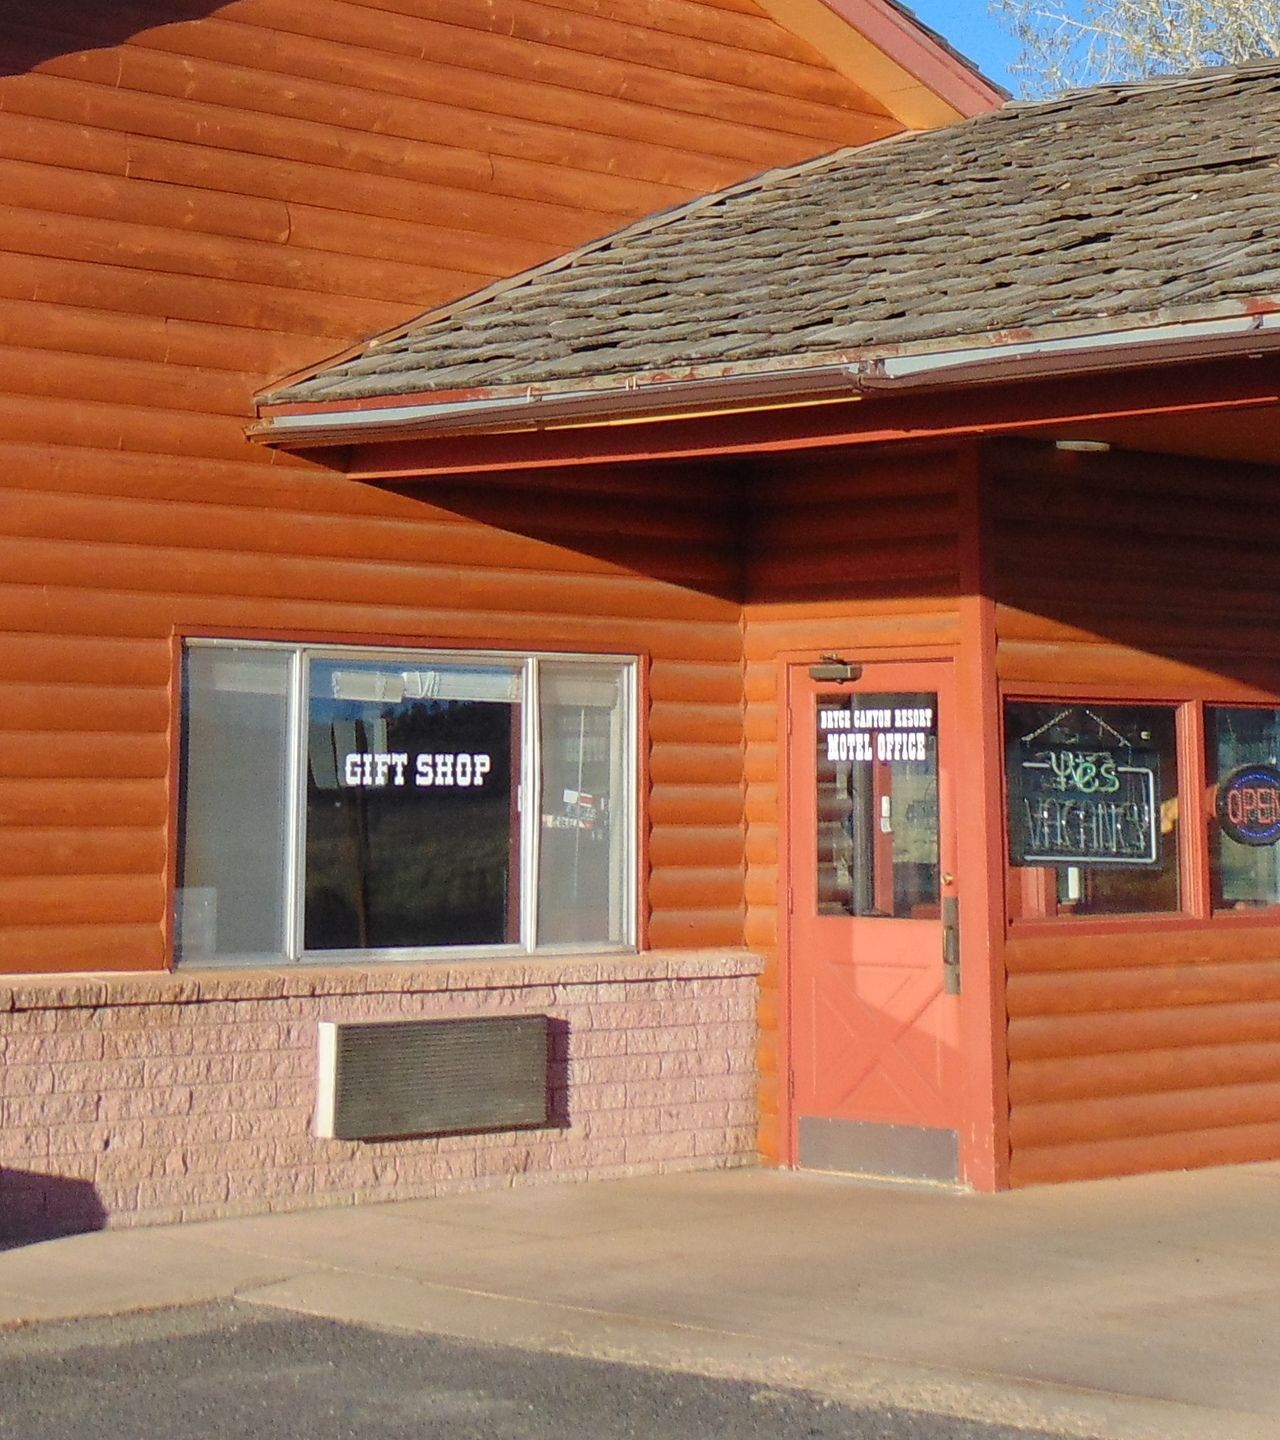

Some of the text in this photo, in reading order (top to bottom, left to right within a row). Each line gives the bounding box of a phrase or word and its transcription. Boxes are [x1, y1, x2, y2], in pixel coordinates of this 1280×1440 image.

[821, 708, 933, 729] BRYCE CANYON RESORT
[827, 732, 926, 760] MOTEL OFFICE
[345, 752, 491, 786] GIFT SHOP
